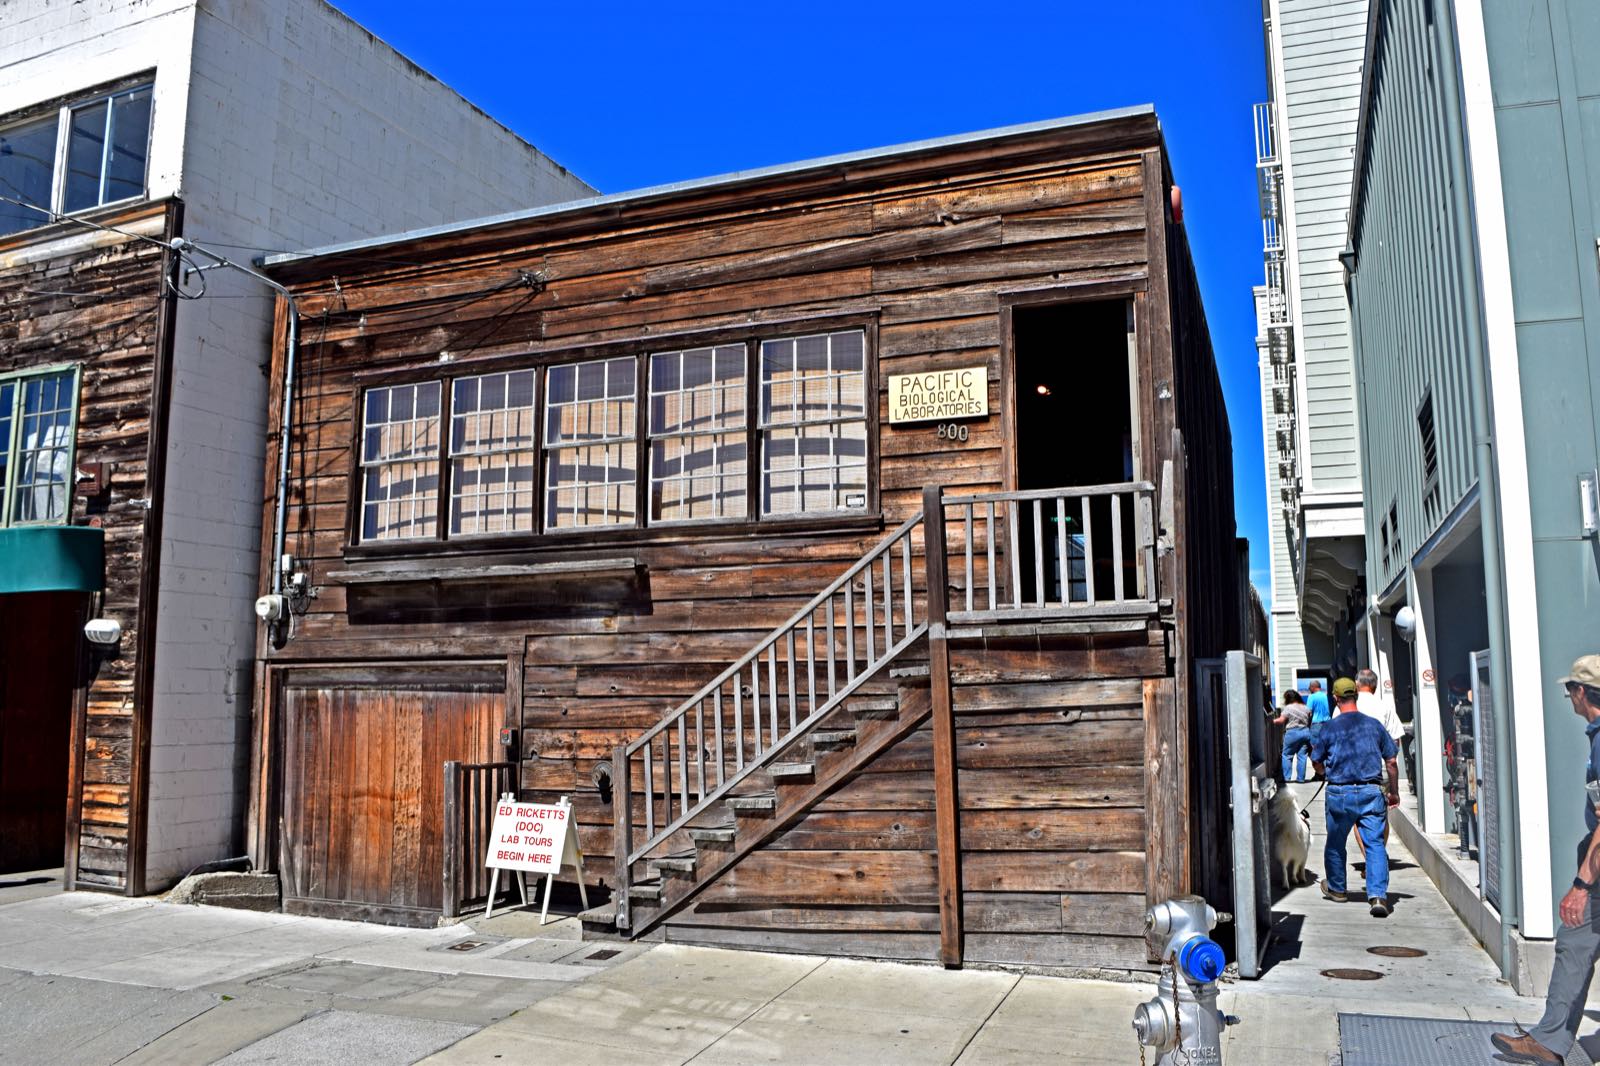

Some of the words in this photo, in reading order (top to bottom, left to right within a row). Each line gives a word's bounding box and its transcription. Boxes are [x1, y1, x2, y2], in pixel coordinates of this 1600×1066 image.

[901, 371, 972, 393] PACIFIC
[899, 389, 975, 407] BIOLOGICAL
[895, 401, 982, 420] LABORATORIES
[937, 423, 968, 441] 800
[499, 806, 512, 816] ED
[516, 807, 565, 820] RICKETTS
[515, 821, 543, 834] (DOC)
[501, 834, 519, 844] LAB
[524, 836, 552, 847] TOURS
[497, 850, 524, 861] BEGIN
[528, 854, 552, 864] HERE
